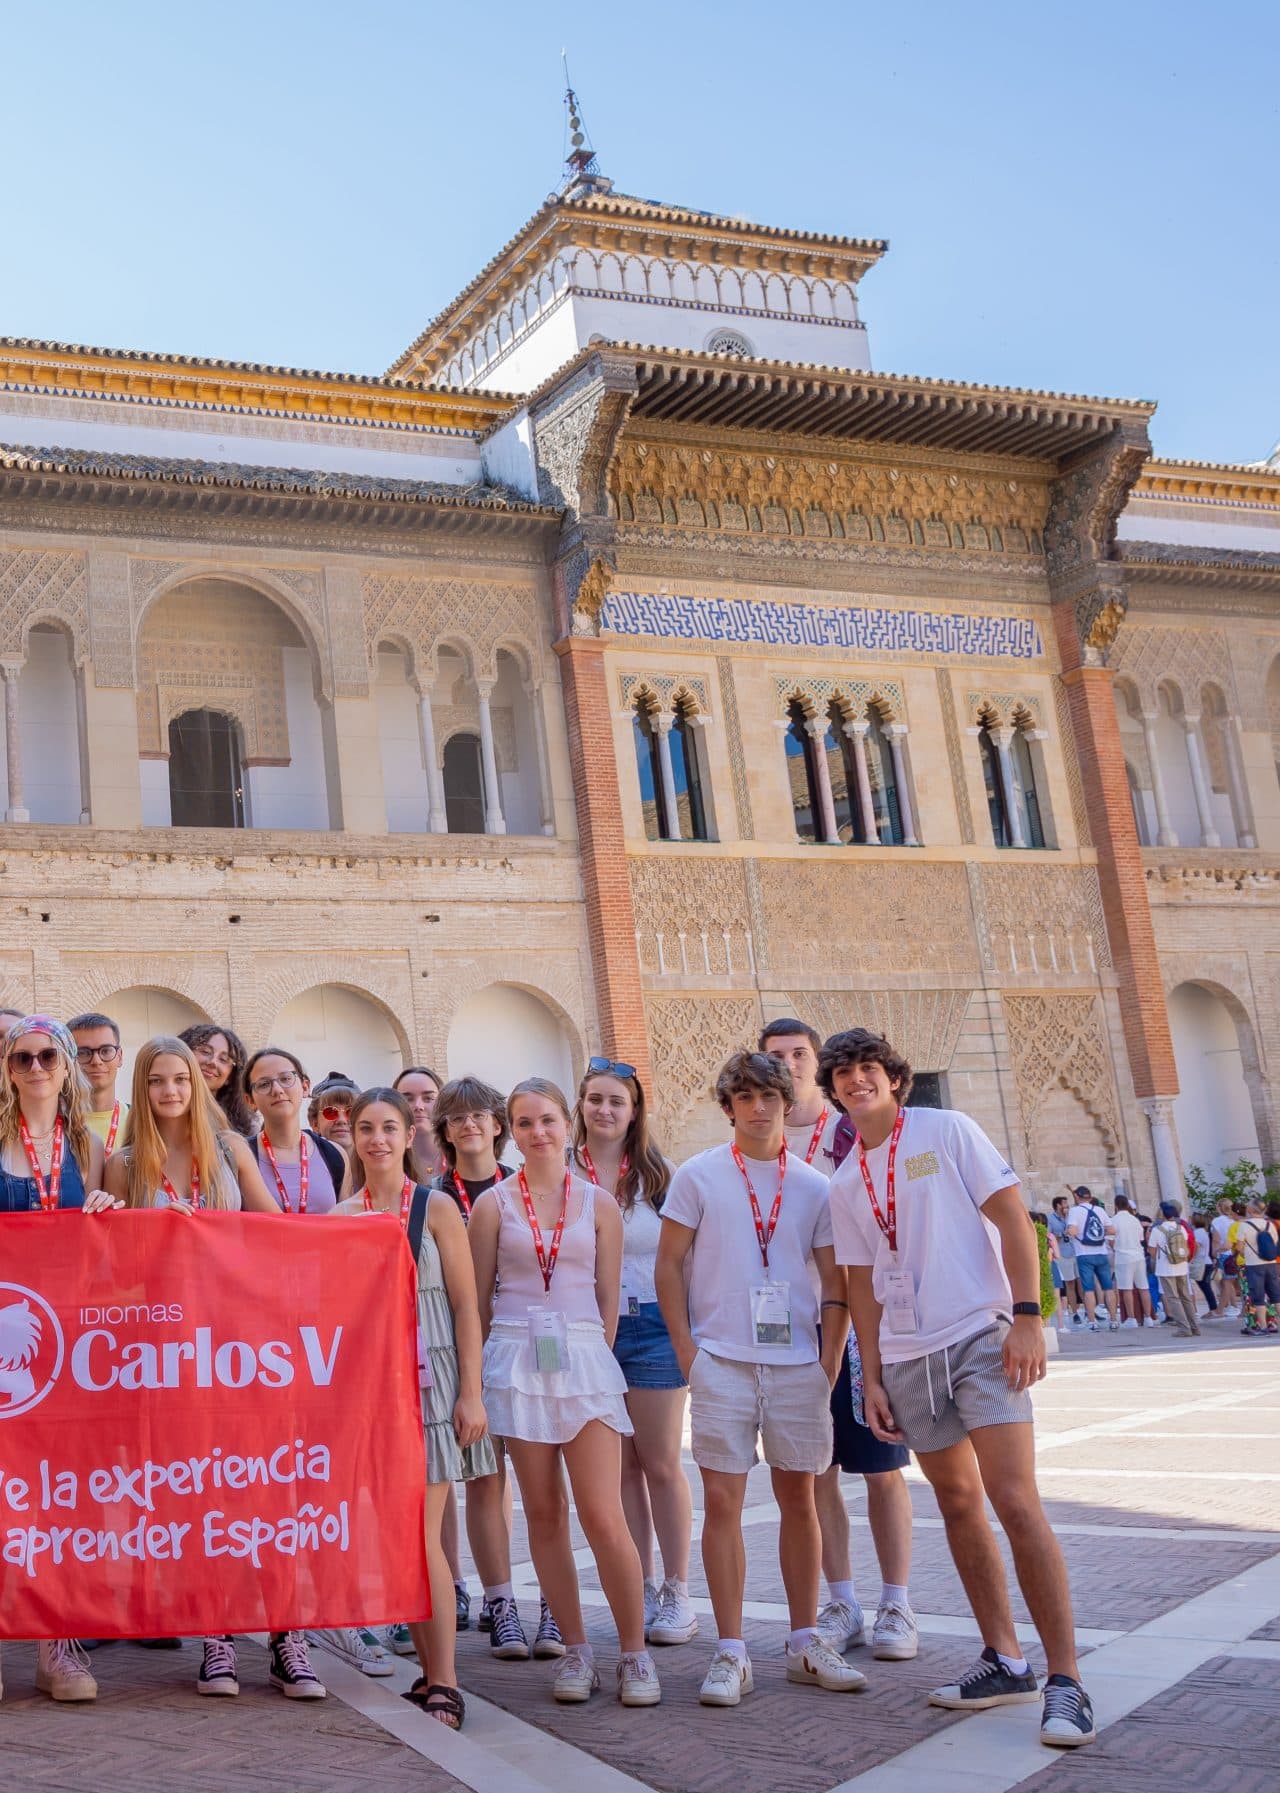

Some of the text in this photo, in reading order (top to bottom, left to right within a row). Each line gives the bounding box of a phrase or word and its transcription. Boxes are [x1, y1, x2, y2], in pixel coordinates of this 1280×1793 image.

[70, 1325, 343, 1392] Carlos V
[39, 1459, 78, 1511] la
[88, 1438, 331, 1512] experiencia
[2, 1515, 192, 1578] aprender
[202, 1500, 350, 1569] Español
